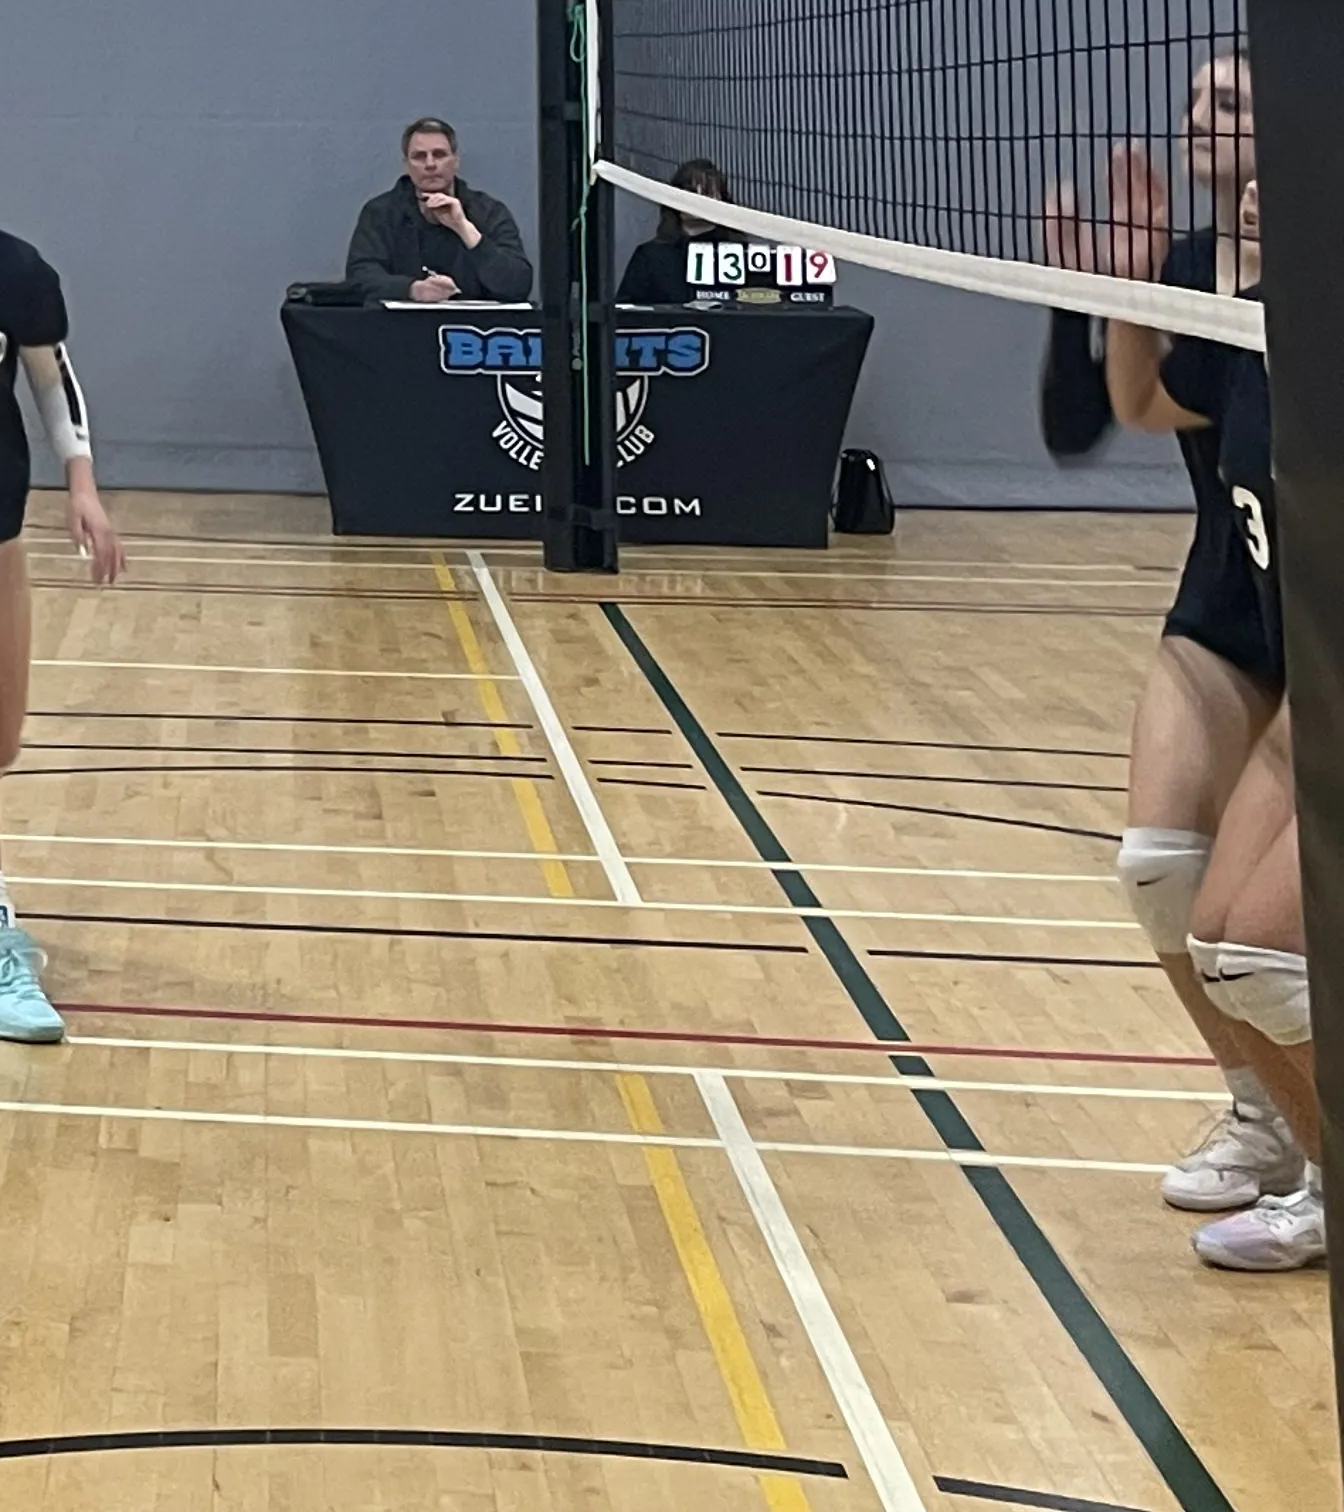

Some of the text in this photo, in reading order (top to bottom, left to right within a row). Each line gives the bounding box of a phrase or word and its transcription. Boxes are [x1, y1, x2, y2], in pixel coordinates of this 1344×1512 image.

[694, 251, 829, 283] 13 0 19
[696, 290, 730, 300] HOME
[790, 292, 826, 302] GUEST
[1232, 485, 1269, 570] 3
